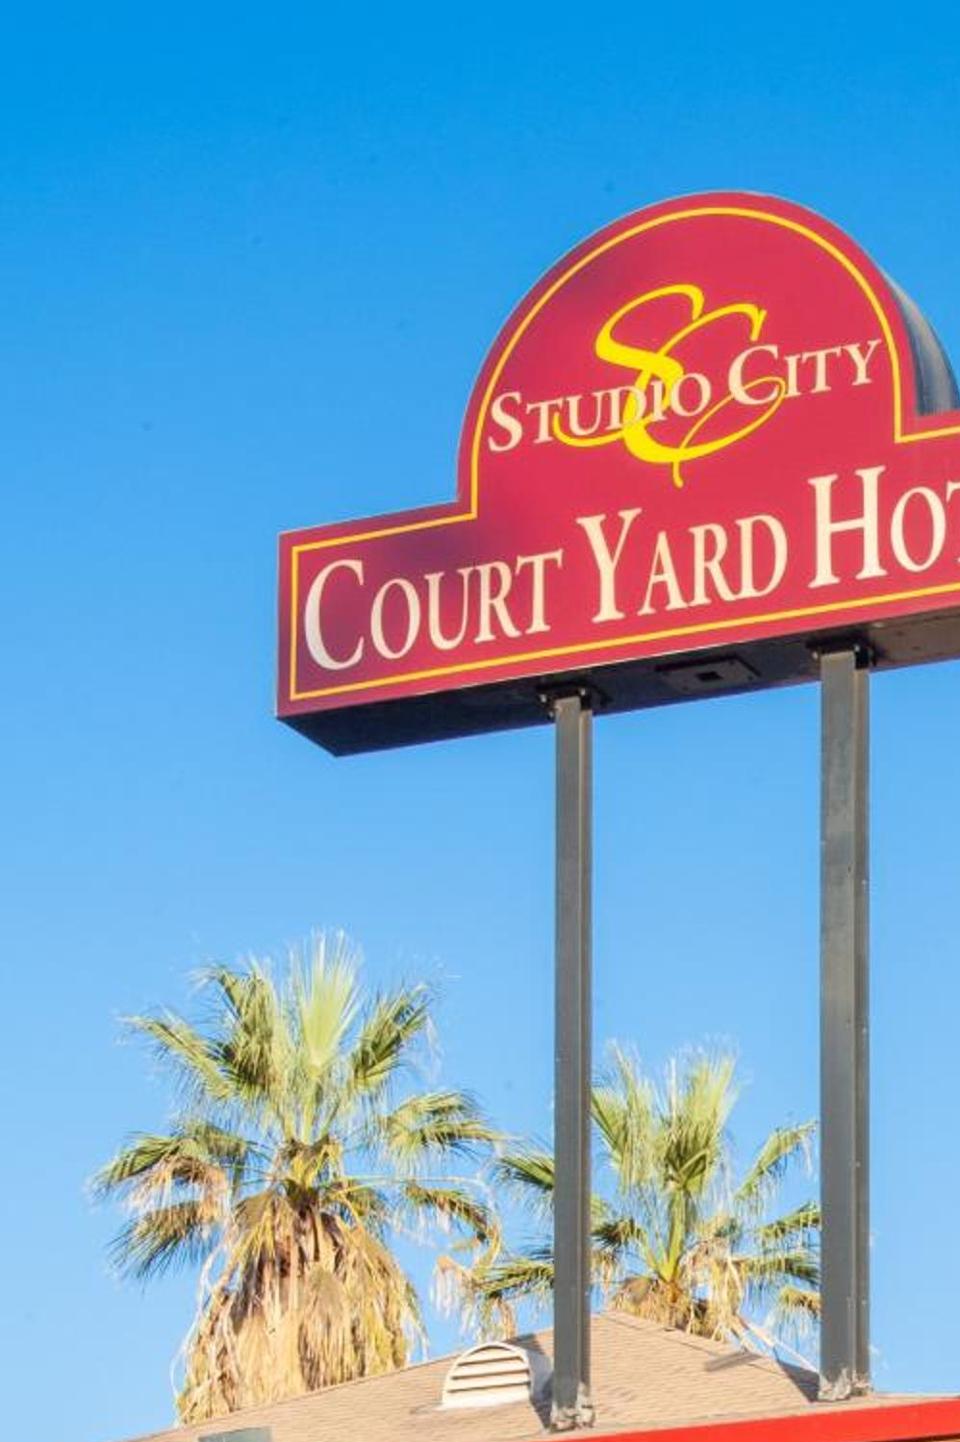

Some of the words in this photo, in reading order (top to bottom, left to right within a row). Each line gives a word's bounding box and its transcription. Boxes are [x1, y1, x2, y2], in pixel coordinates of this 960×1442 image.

[487, 372, 711, 453] STUDIO
[728, 338, 882, 406] CITY
[304, 548, 564, 671] COURT
[576, 507, 788, 623] YARD
